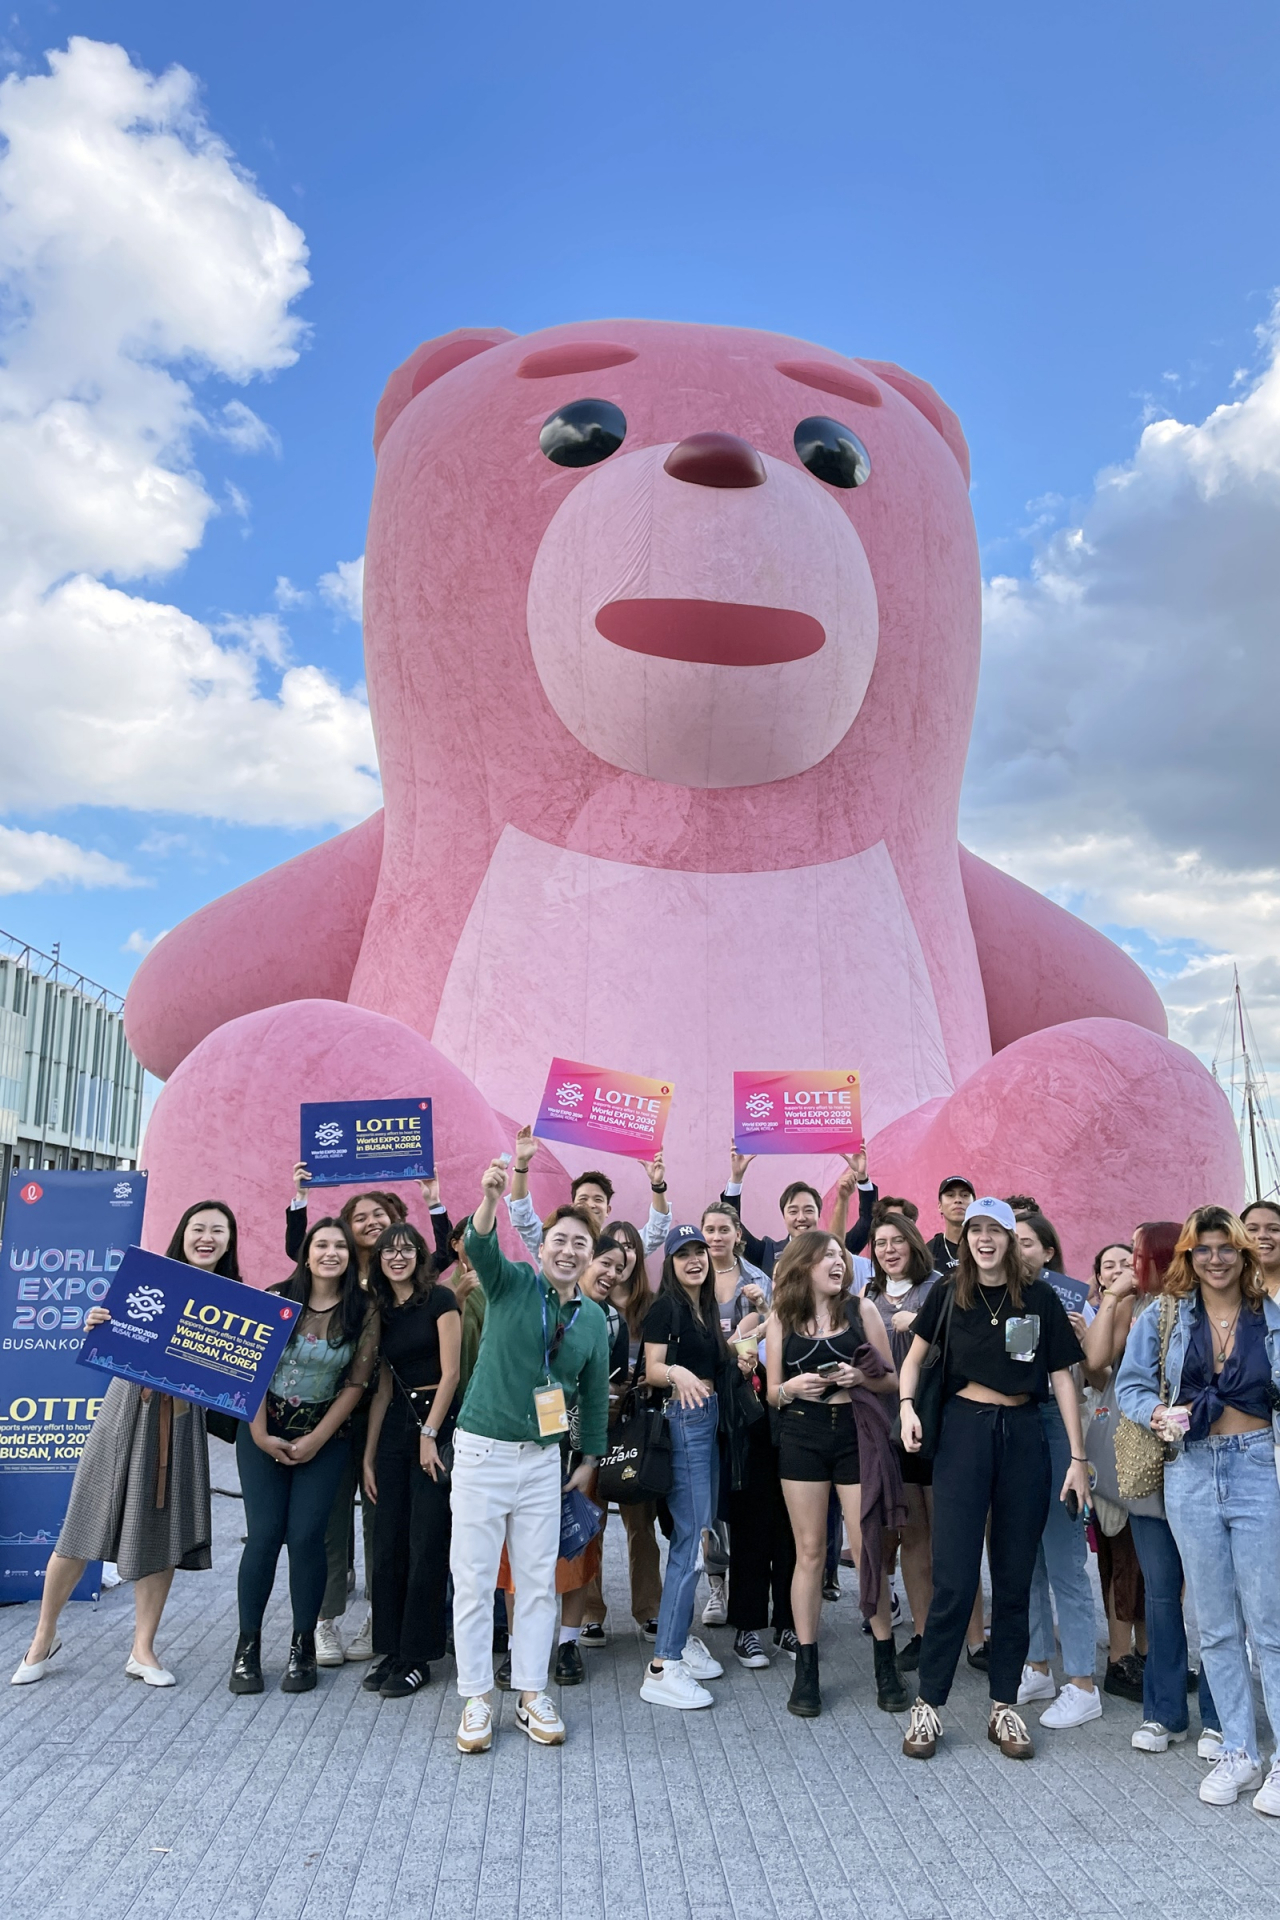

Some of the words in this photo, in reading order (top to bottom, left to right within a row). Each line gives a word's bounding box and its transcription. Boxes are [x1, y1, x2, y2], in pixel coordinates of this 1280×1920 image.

[594, 1087, 661, 1114] LOTTE
[783, 1091, 851, 1105] LOTTE
[591, 1105, 613, 1116] World
[614, 1111, 635, 1121] EXPO
[635, 1116, 656, 1126] 2030
[784, 1110, 807, 1118] World
[807, 1110, 830, 1118] EXPO
[830, 1110, 852, 1118] 2030
[793, 1118, 824, 1127] BUSAN,
[356, 1117, 421, 1132] LOTTE
[598, 1115, 627, 1128] BUSAN,
[628, 1122, 655, 1133] KOREA
[356, 1136, 378, 1144] World
[379, 1135, 400, 1143] EXPO
[400, 1134, 421, 1142] 2030
[365, 1143, 394, 1151] BUSAN,
[395, 1141, 422, 1149] KOREA
[9, 1247, 126, 1273] WORLD
[17, 1276, 111, 1302] EXPO
[1049, 1283, 1083, 1302] ORLD
[110, 1319, 128, 1329] World
[127, 1324, 143, 1334] EXPO
[143, 1329, 158, 1340] 2030
[183, 1298, 275, 1344] LOTTE
[132, 1333, 149, 1343] KOREA
[176, 1325, 206, 1341] World
[205, 1334, 234, 1351] EXPO
[234, 1345, 262, 1361] 2030
[179, 1318, 204, 1330] supports
[204, 1326, 220, 1337] every
[220, 1332, 236, 1341] effort
[243, 1338, 256, 1348] host
[256, 1343, 266, 1351] the
[170, 1334, 181, 1345] in
[182, 1338, 220, 1361] BUSAN,
[221, 1351, 258, 1371] KOREA
[22, 1424, 43, 1432] every
[44, 1423, 64, 1431] effort
[75, 1423, 91, 1431] host
[0, 1433, 26, 1445] orld
[27, 1433, 65, 1445] EXPO
[67, 1433, 90, 1445] 20
[0, 1447, 51, 1462] BUSAN,
[54, 1447, 84, 1459] KOR
